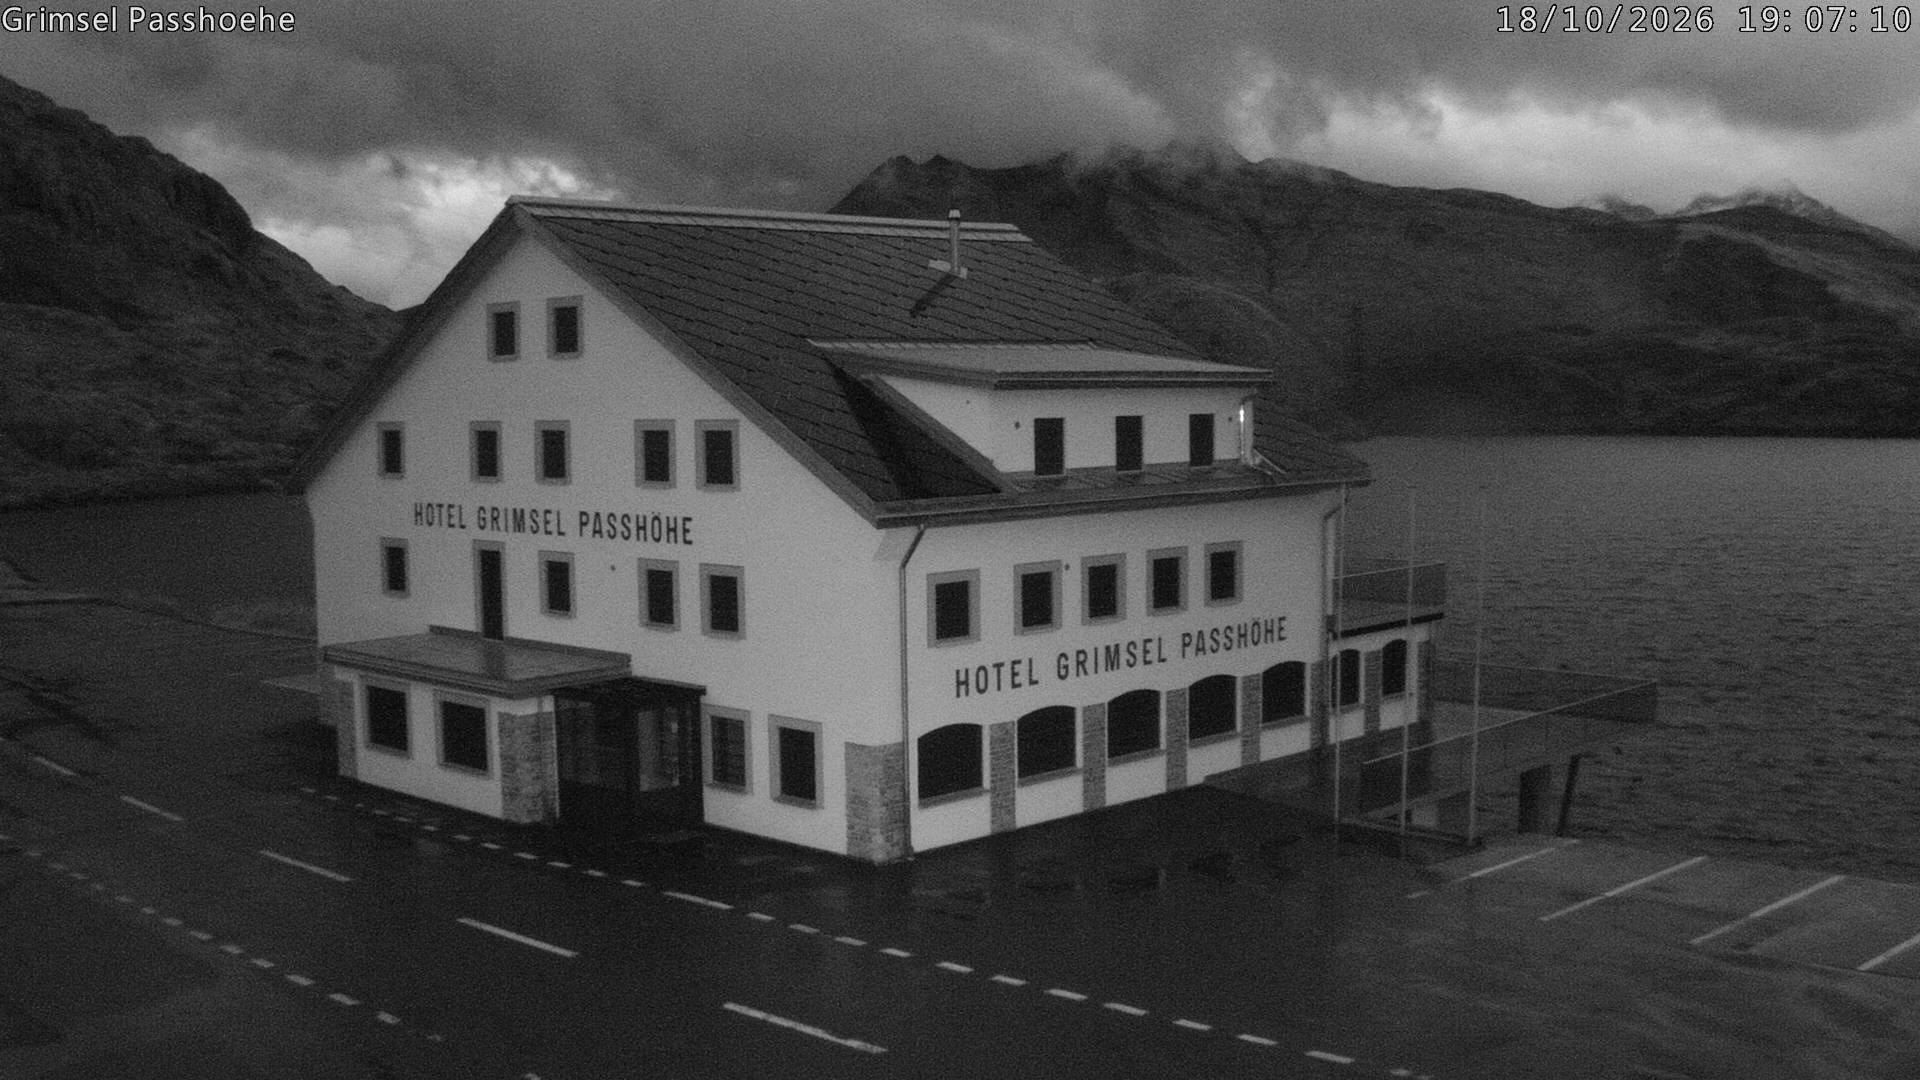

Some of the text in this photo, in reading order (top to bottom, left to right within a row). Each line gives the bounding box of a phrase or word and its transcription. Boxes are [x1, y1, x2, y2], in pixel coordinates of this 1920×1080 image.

[414, 503, 693, 545] HOTEL GRIMSEL PASSHÖHE
[955, 616, 1288, 698] HOTEL GRIMSEL PASSHÖHE
